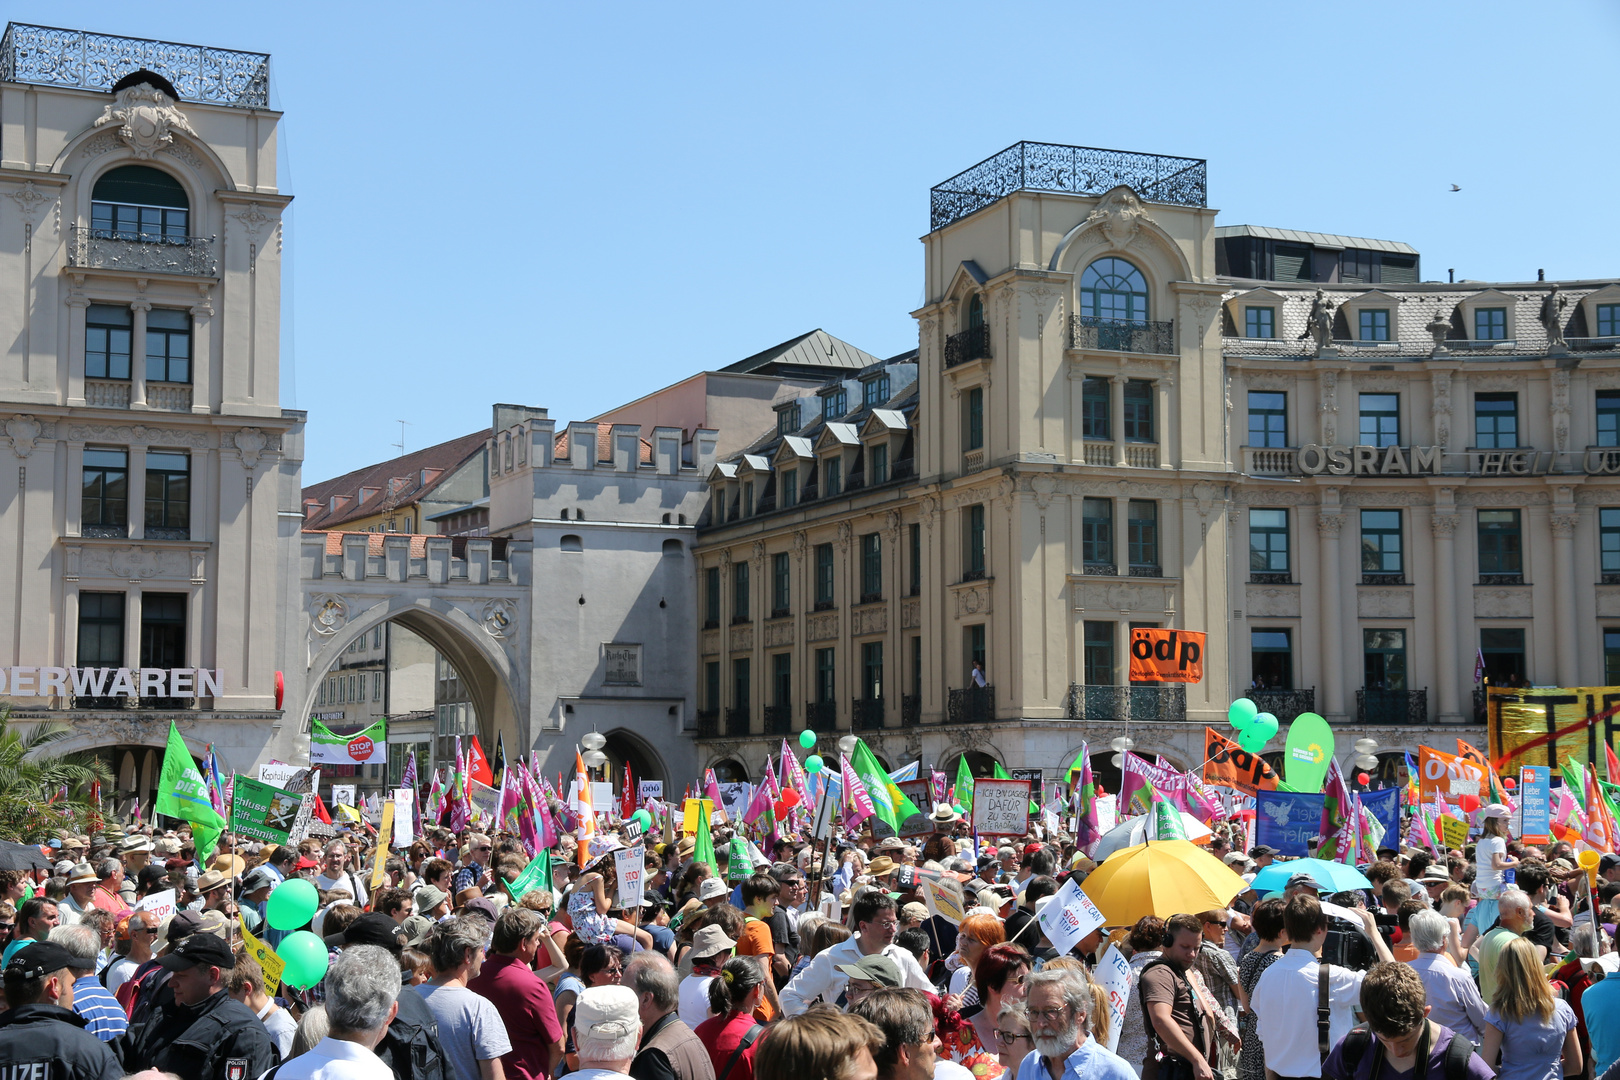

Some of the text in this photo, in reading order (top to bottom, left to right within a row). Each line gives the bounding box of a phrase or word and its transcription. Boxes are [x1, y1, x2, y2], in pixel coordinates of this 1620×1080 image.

[1298, 444, 1442, 476] OSRAM
[1482, 451, 1564, 476] HELL
[1132, 632, 1200, 670] ödp
[350, 742, 371, 752] STOP
[1208, 735, 1277, 785] ödp
[1524, 772, 1534, 782] ödp
[174, 780, 196, 793] DIE
[1524, 786, 1540, 795] Lieber
[982, 789, 993, 798] ICH
[235, 796, 267, 812] chluss
[989, 798, 1020, 811] DAFÜR
[1524, 796, 1544, 808] Bürgern
[235, 808, 250, 820] Gift
[988, 812, 1018, 821] ZU SEIN
[1524, 808, 1545, 816] zuhören
[235, 824, 278, 841] ntechnik!
[625, 870, 640, 881] STO
[1072, 886, 1101, 921] YES WE CAN
[1064, 910, 1079, 926] STOP
[1112, 954, 1128, 975] YES
[1109, 991, 1126, 1018] STO
